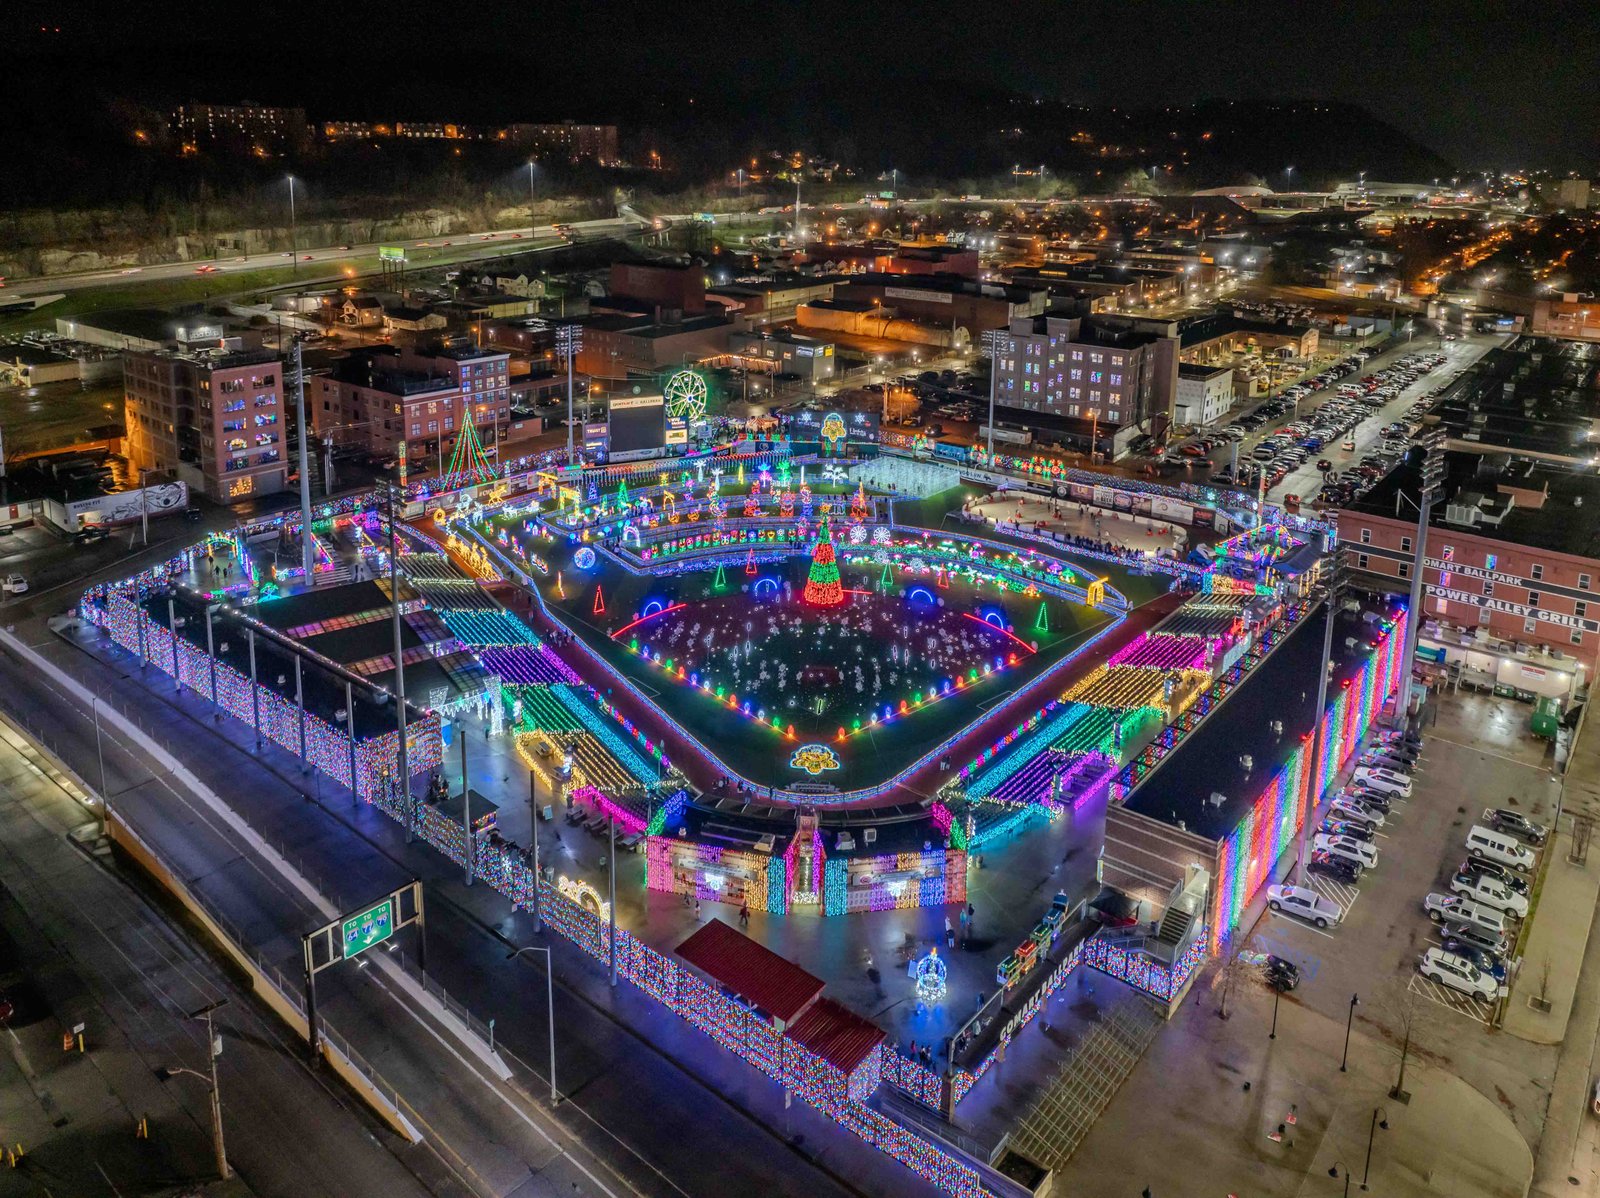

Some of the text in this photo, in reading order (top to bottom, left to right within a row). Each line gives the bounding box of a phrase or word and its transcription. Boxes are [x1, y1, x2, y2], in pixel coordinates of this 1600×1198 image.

[1422, 558, 1523, 587] OMART BALLPARK
[1426, 585, 1587, 629] POWER ALLEY GRILL
[378, 906, 387, 914] TO
[363, 913, 372, 921] TO
[348, 920, 357, 929] TO
[348, 930, 359, 941] 64
[999, 936, 1087, 1042] GOMART BALLPARK
